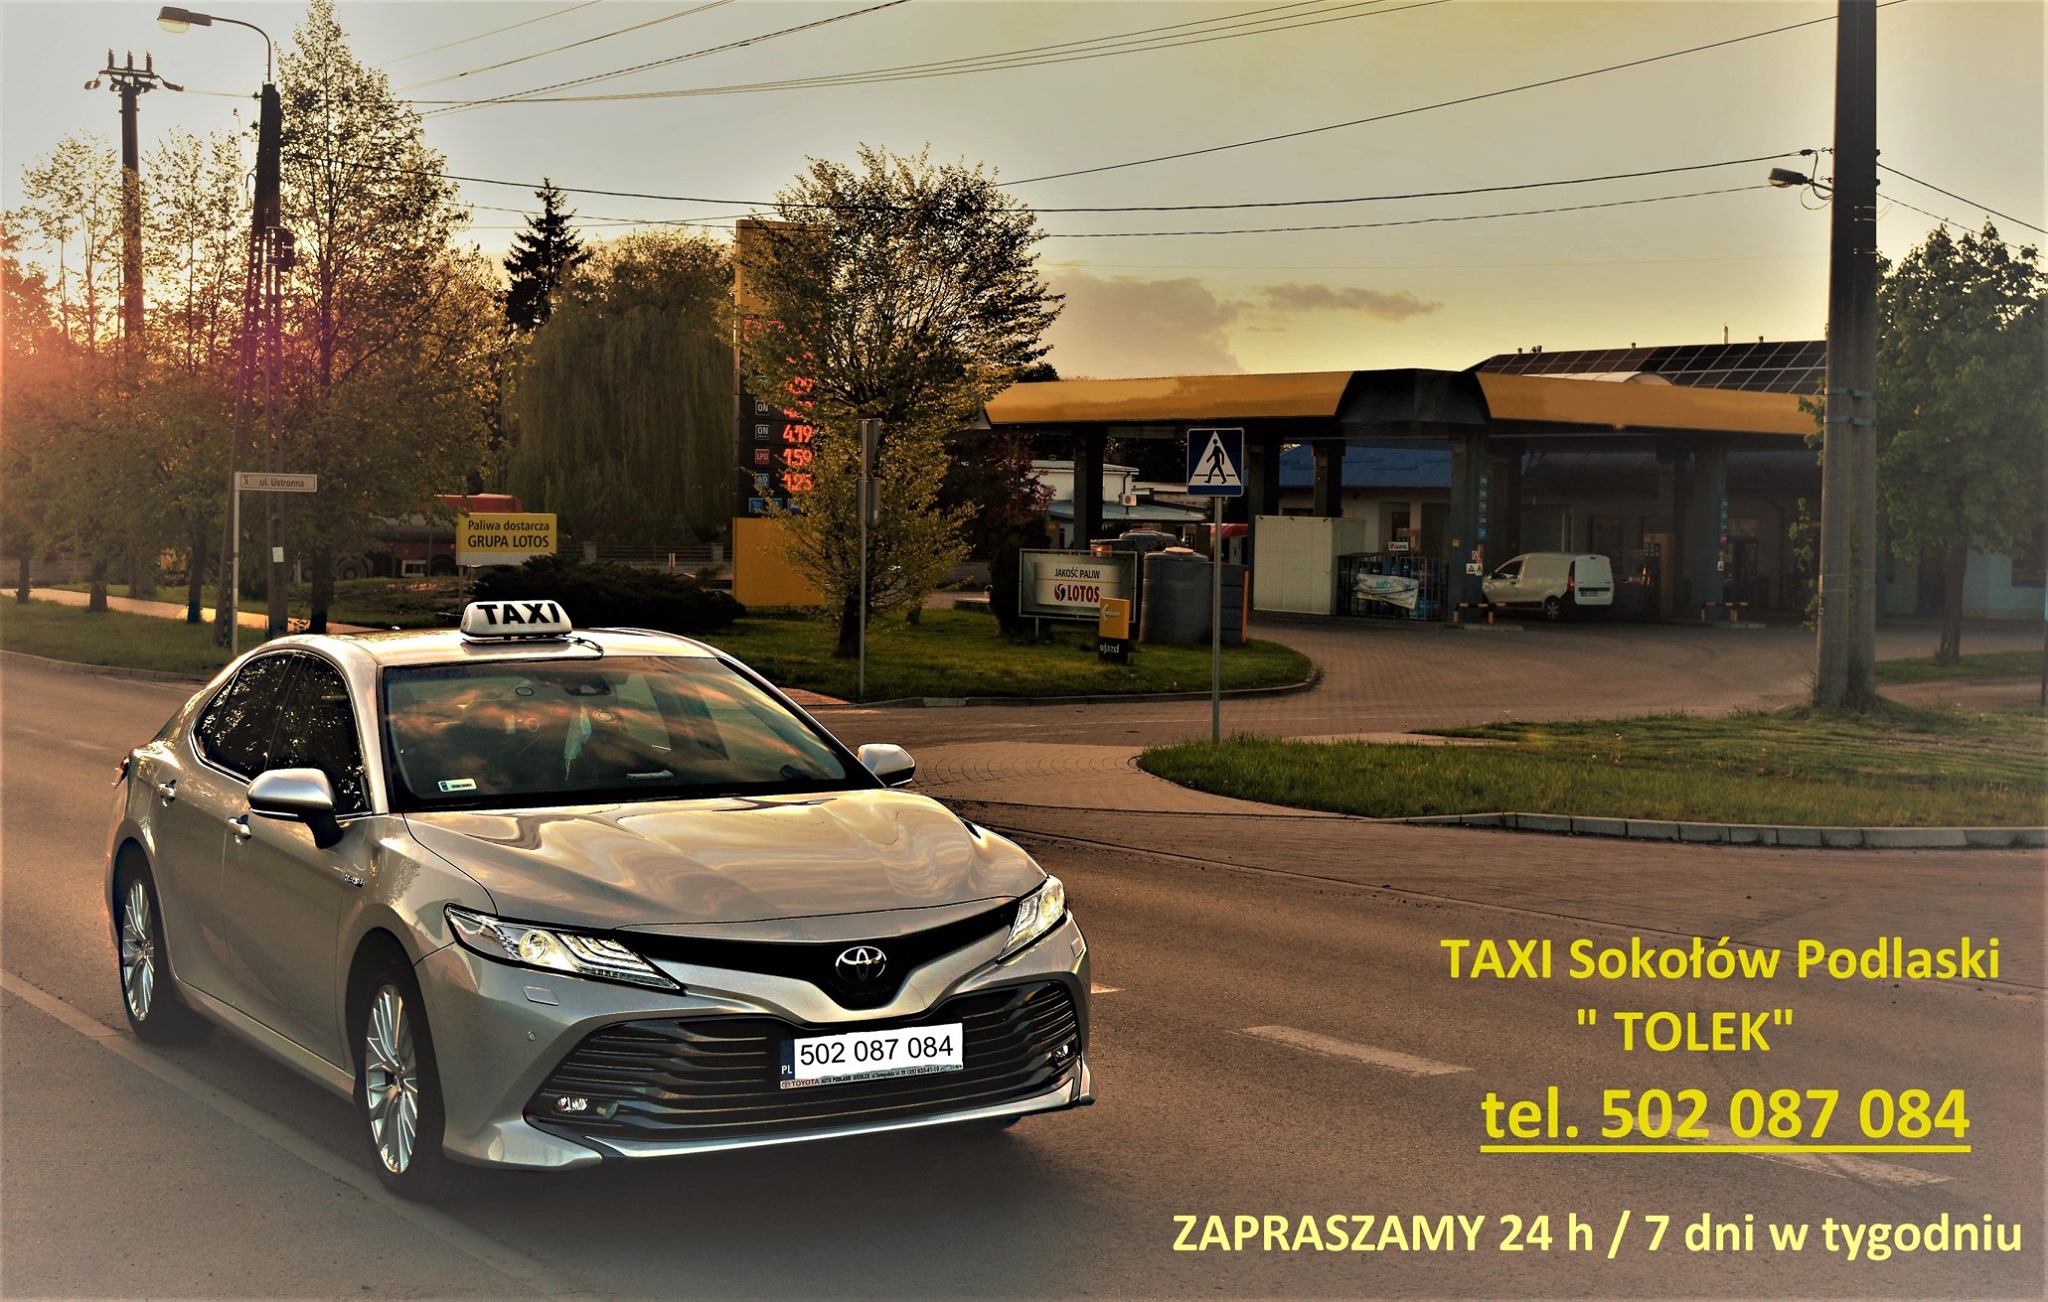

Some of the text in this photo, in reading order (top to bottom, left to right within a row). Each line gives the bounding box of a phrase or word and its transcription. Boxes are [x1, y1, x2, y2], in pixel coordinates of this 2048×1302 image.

[757, 403, 769, 412] ON
[757, 427, 769, 435] ON
[756, 453, 769, 461] LPG
[259, 478, 305, 488] ul. Ustronna
[468, 520, 550, 532] Paliwa dostarcza
[468, 535, 549, 548] GRUPA LOTOS
[1054, 567, 1101, 580] JAKOŚĆ PALIW
[1067, 584, 1101, 603] LOTOS
[476, 603, 561, 625] TAXI
[800, 1034, 953, 1066] 502 087 084
[781, 1065, 793, 1075] PL
[791, 1078, 820, 1088] TOYOTA
